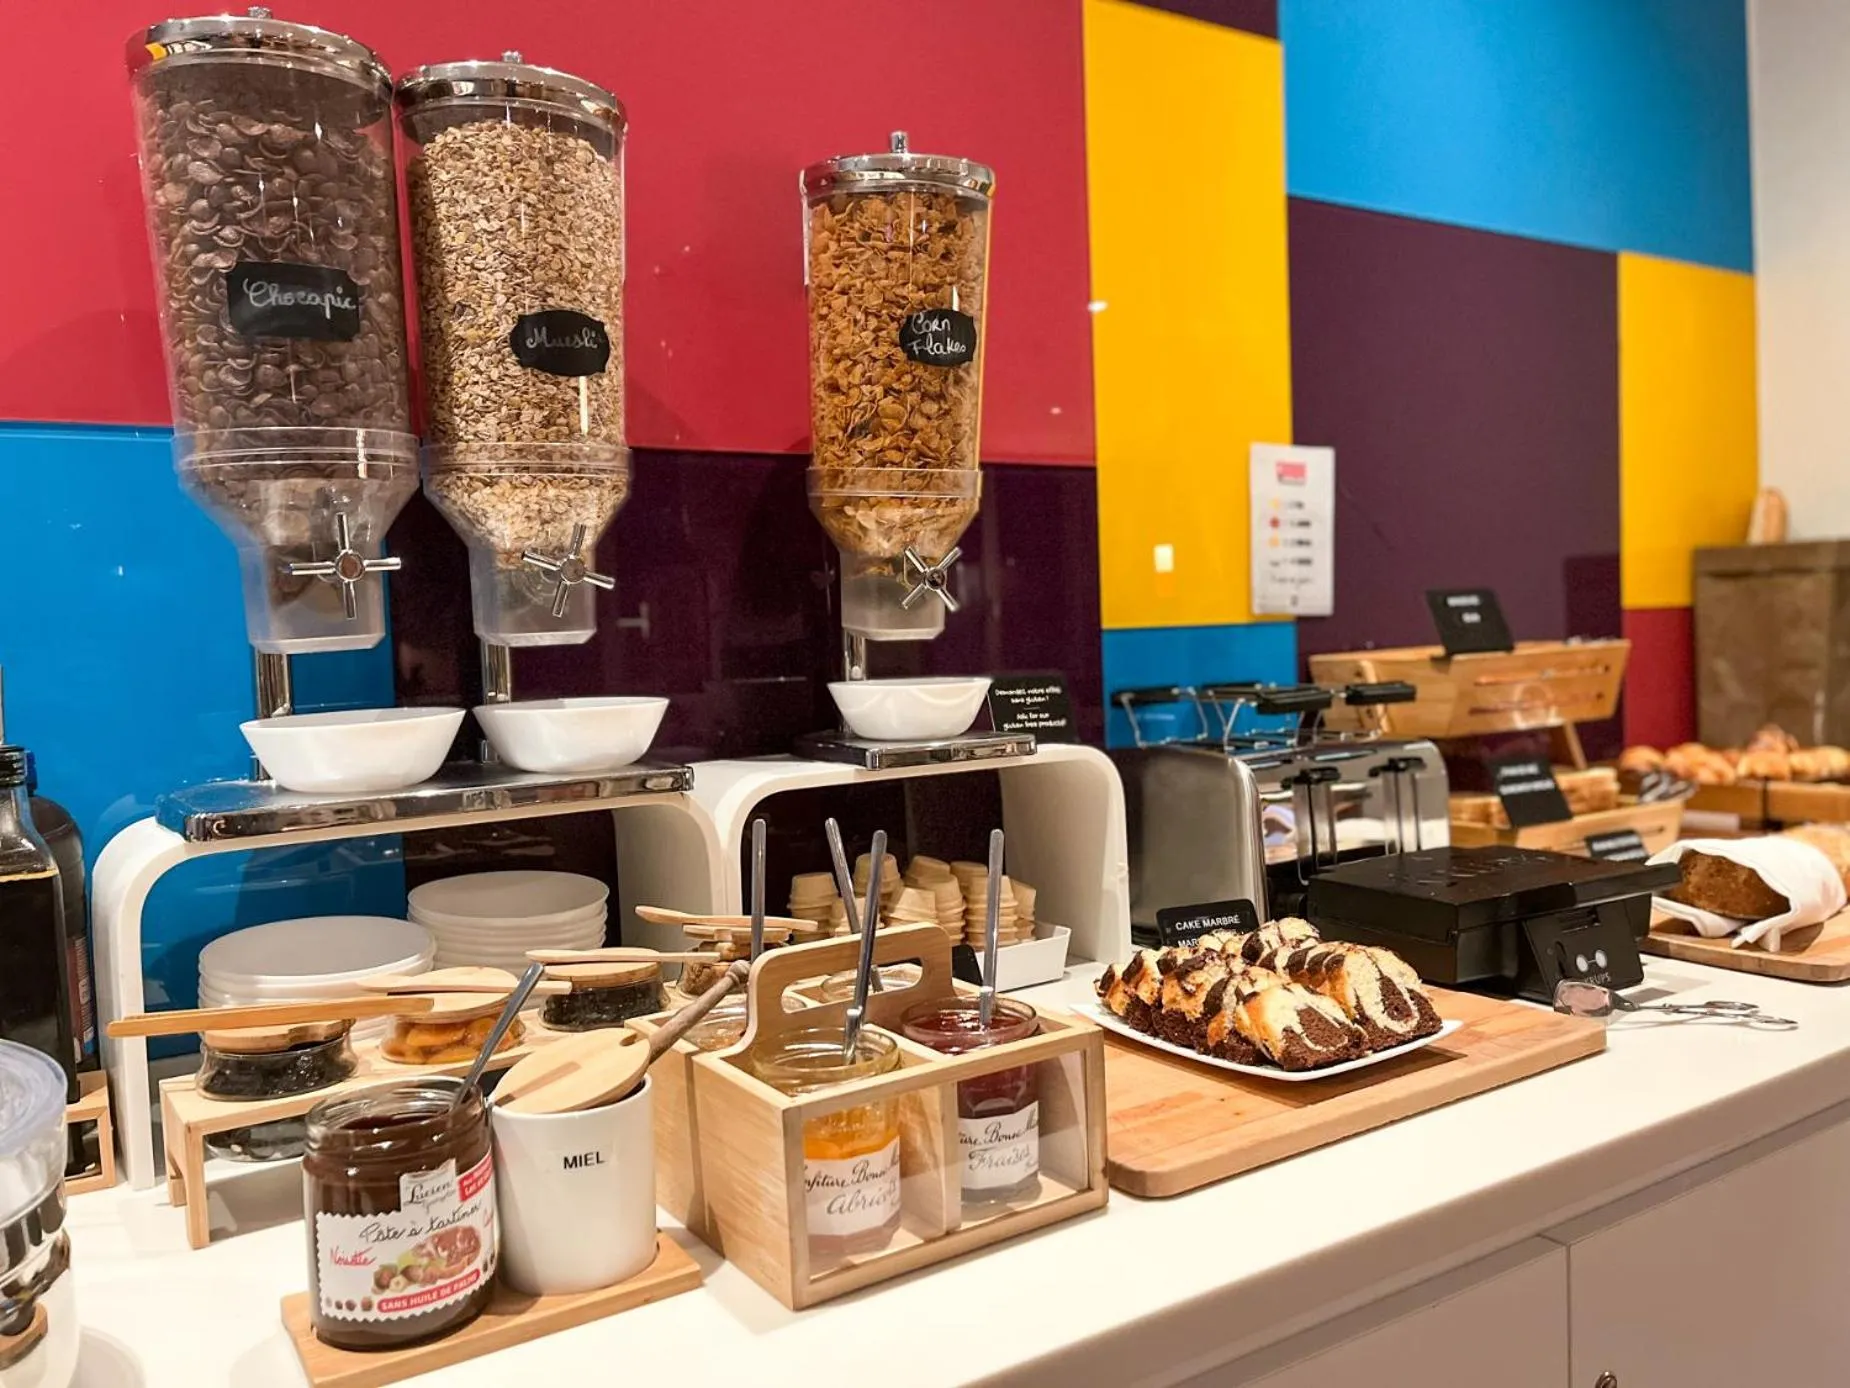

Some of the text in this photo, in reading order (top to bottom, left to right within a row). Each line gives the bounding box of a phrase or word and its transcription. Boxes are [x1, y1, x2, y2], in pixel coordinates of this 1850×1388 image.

[243, 278, 356, 319] Chocapic
[912, 311, 951, 334] Corn
[526, 326, 598, 348] Muesli
[908, 333, 967, 355] Flakes
[1175, 914, 1241, 930] CAKE MARBRÉ
[1177, 938, 1199, 947] MAR
[983, 1121, 1022, 1143] Bonne
[563, 1151, 605, 1169] MIEL
[425, 1203, 482, 1234] tartiner
[381, 1299, 409, 1312] SANS
[410, 1292, 438, 1306] HUILE
[440, 1286, 453, 1298] DE
